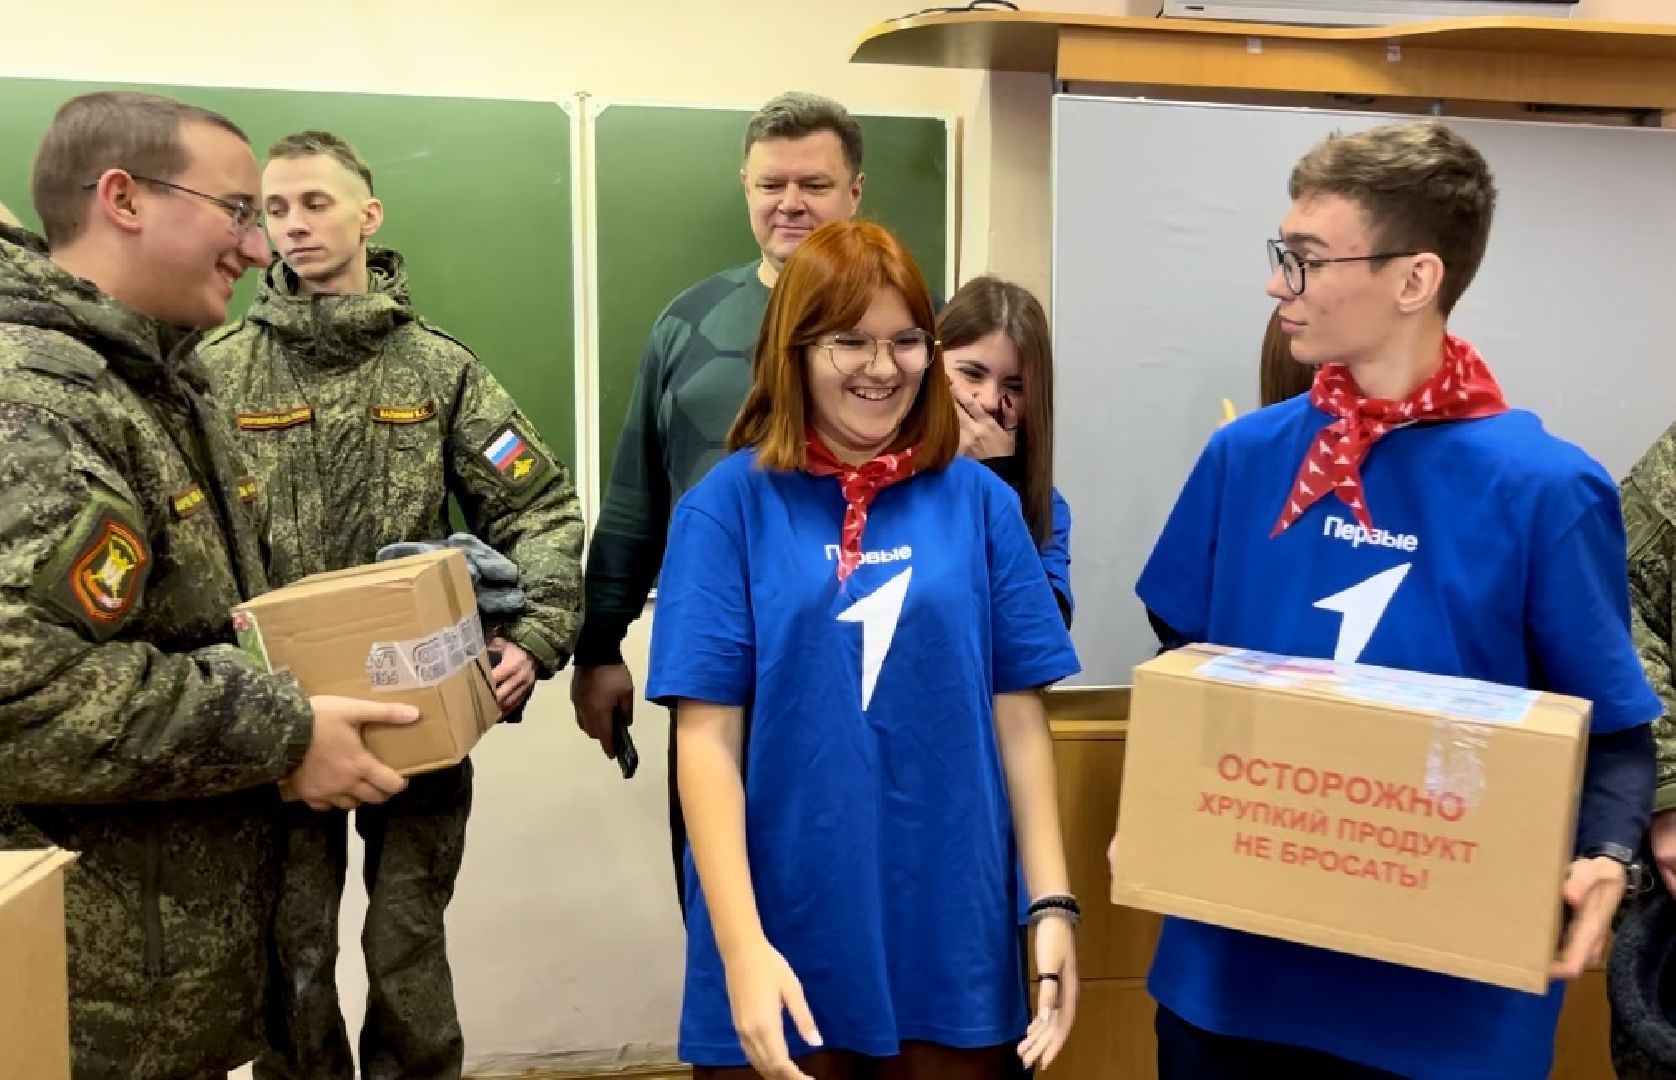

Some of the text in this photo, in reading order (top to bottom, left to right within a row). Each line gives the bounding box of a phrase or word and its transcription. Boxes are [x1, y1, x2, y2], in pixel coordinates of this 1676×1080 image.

[824, 544, 912, 569] Првые
[1324, 515, 1418, 552] Первые
[1218, 753, 1466, 821] ОСТОРОЖНО
[1197, 792, 1478, 863] ХРУПКИЙ ПРОДУКТ
[1234, 832, 1430, 889] НЕ БРОСАТЬ!
